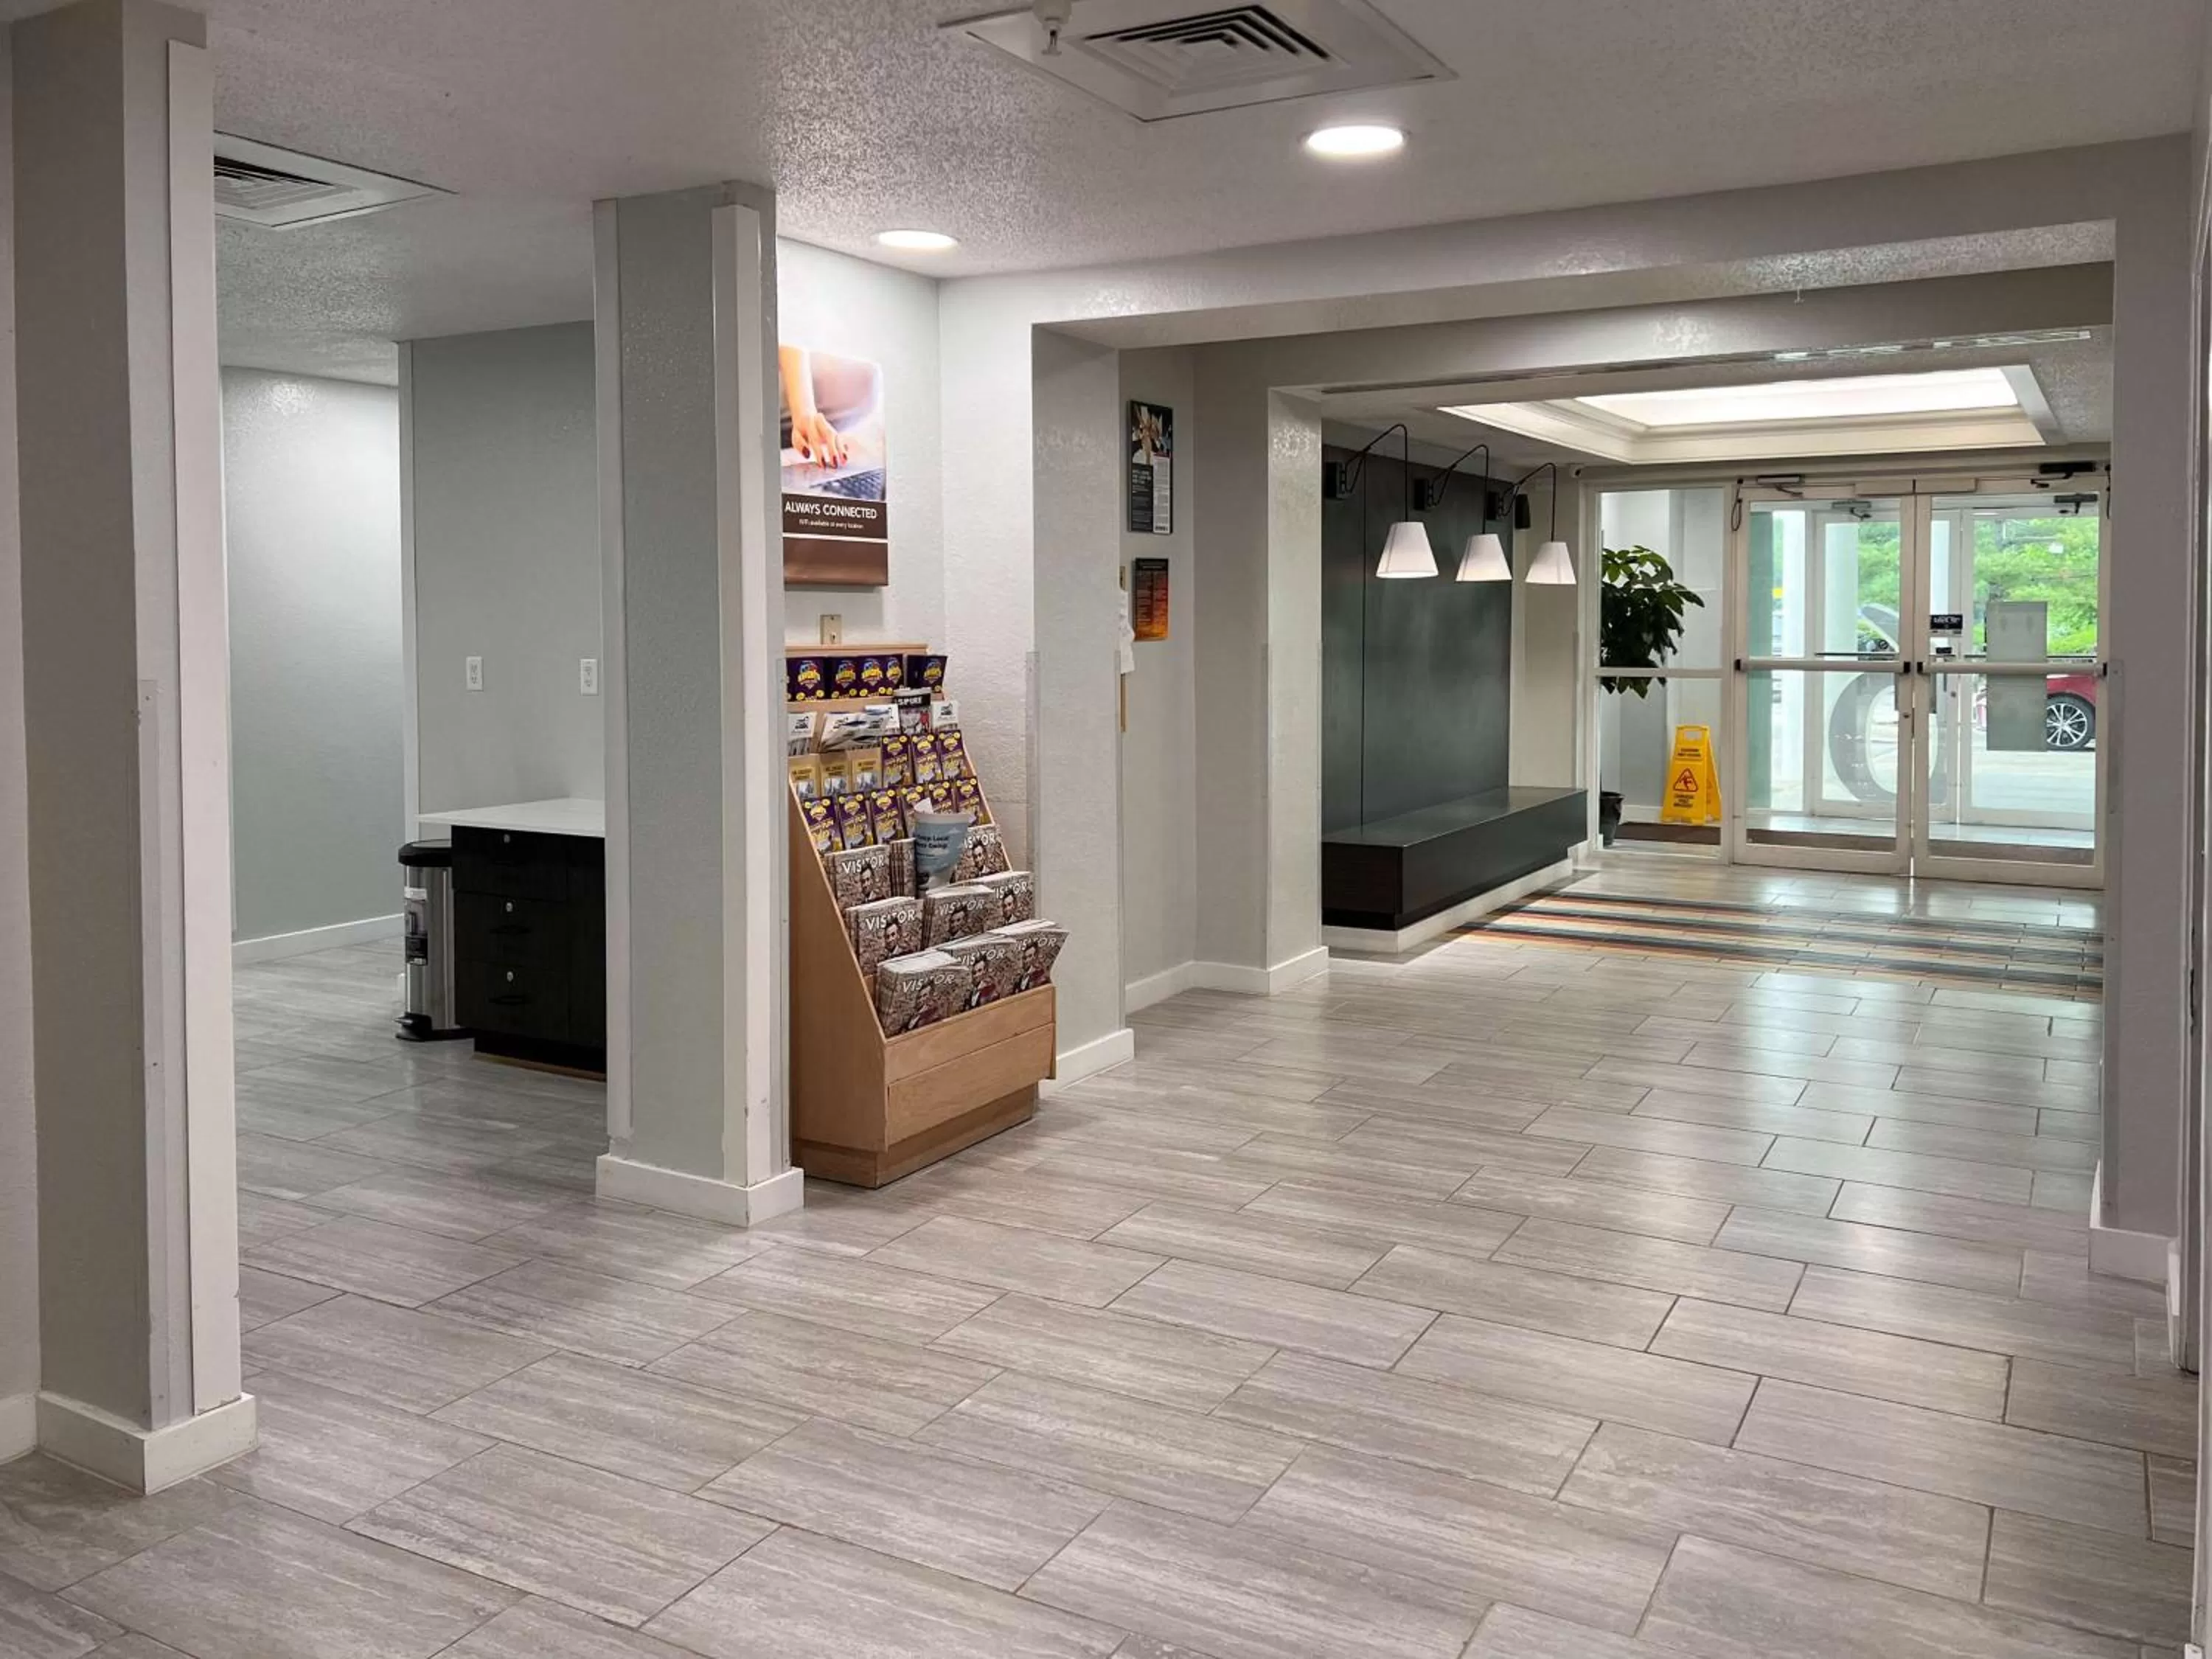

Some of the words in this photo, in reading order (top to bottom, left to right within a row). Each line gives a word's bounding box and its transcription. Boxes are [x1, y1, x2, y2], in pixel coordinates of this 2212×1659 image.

[785, 501, 821, 515] ALWAYS
[823, 505, 877, 519] CONNECTED
[964, 832, 996, 849] ISITOR
[993, 881, 1027, 899] ISITOR
